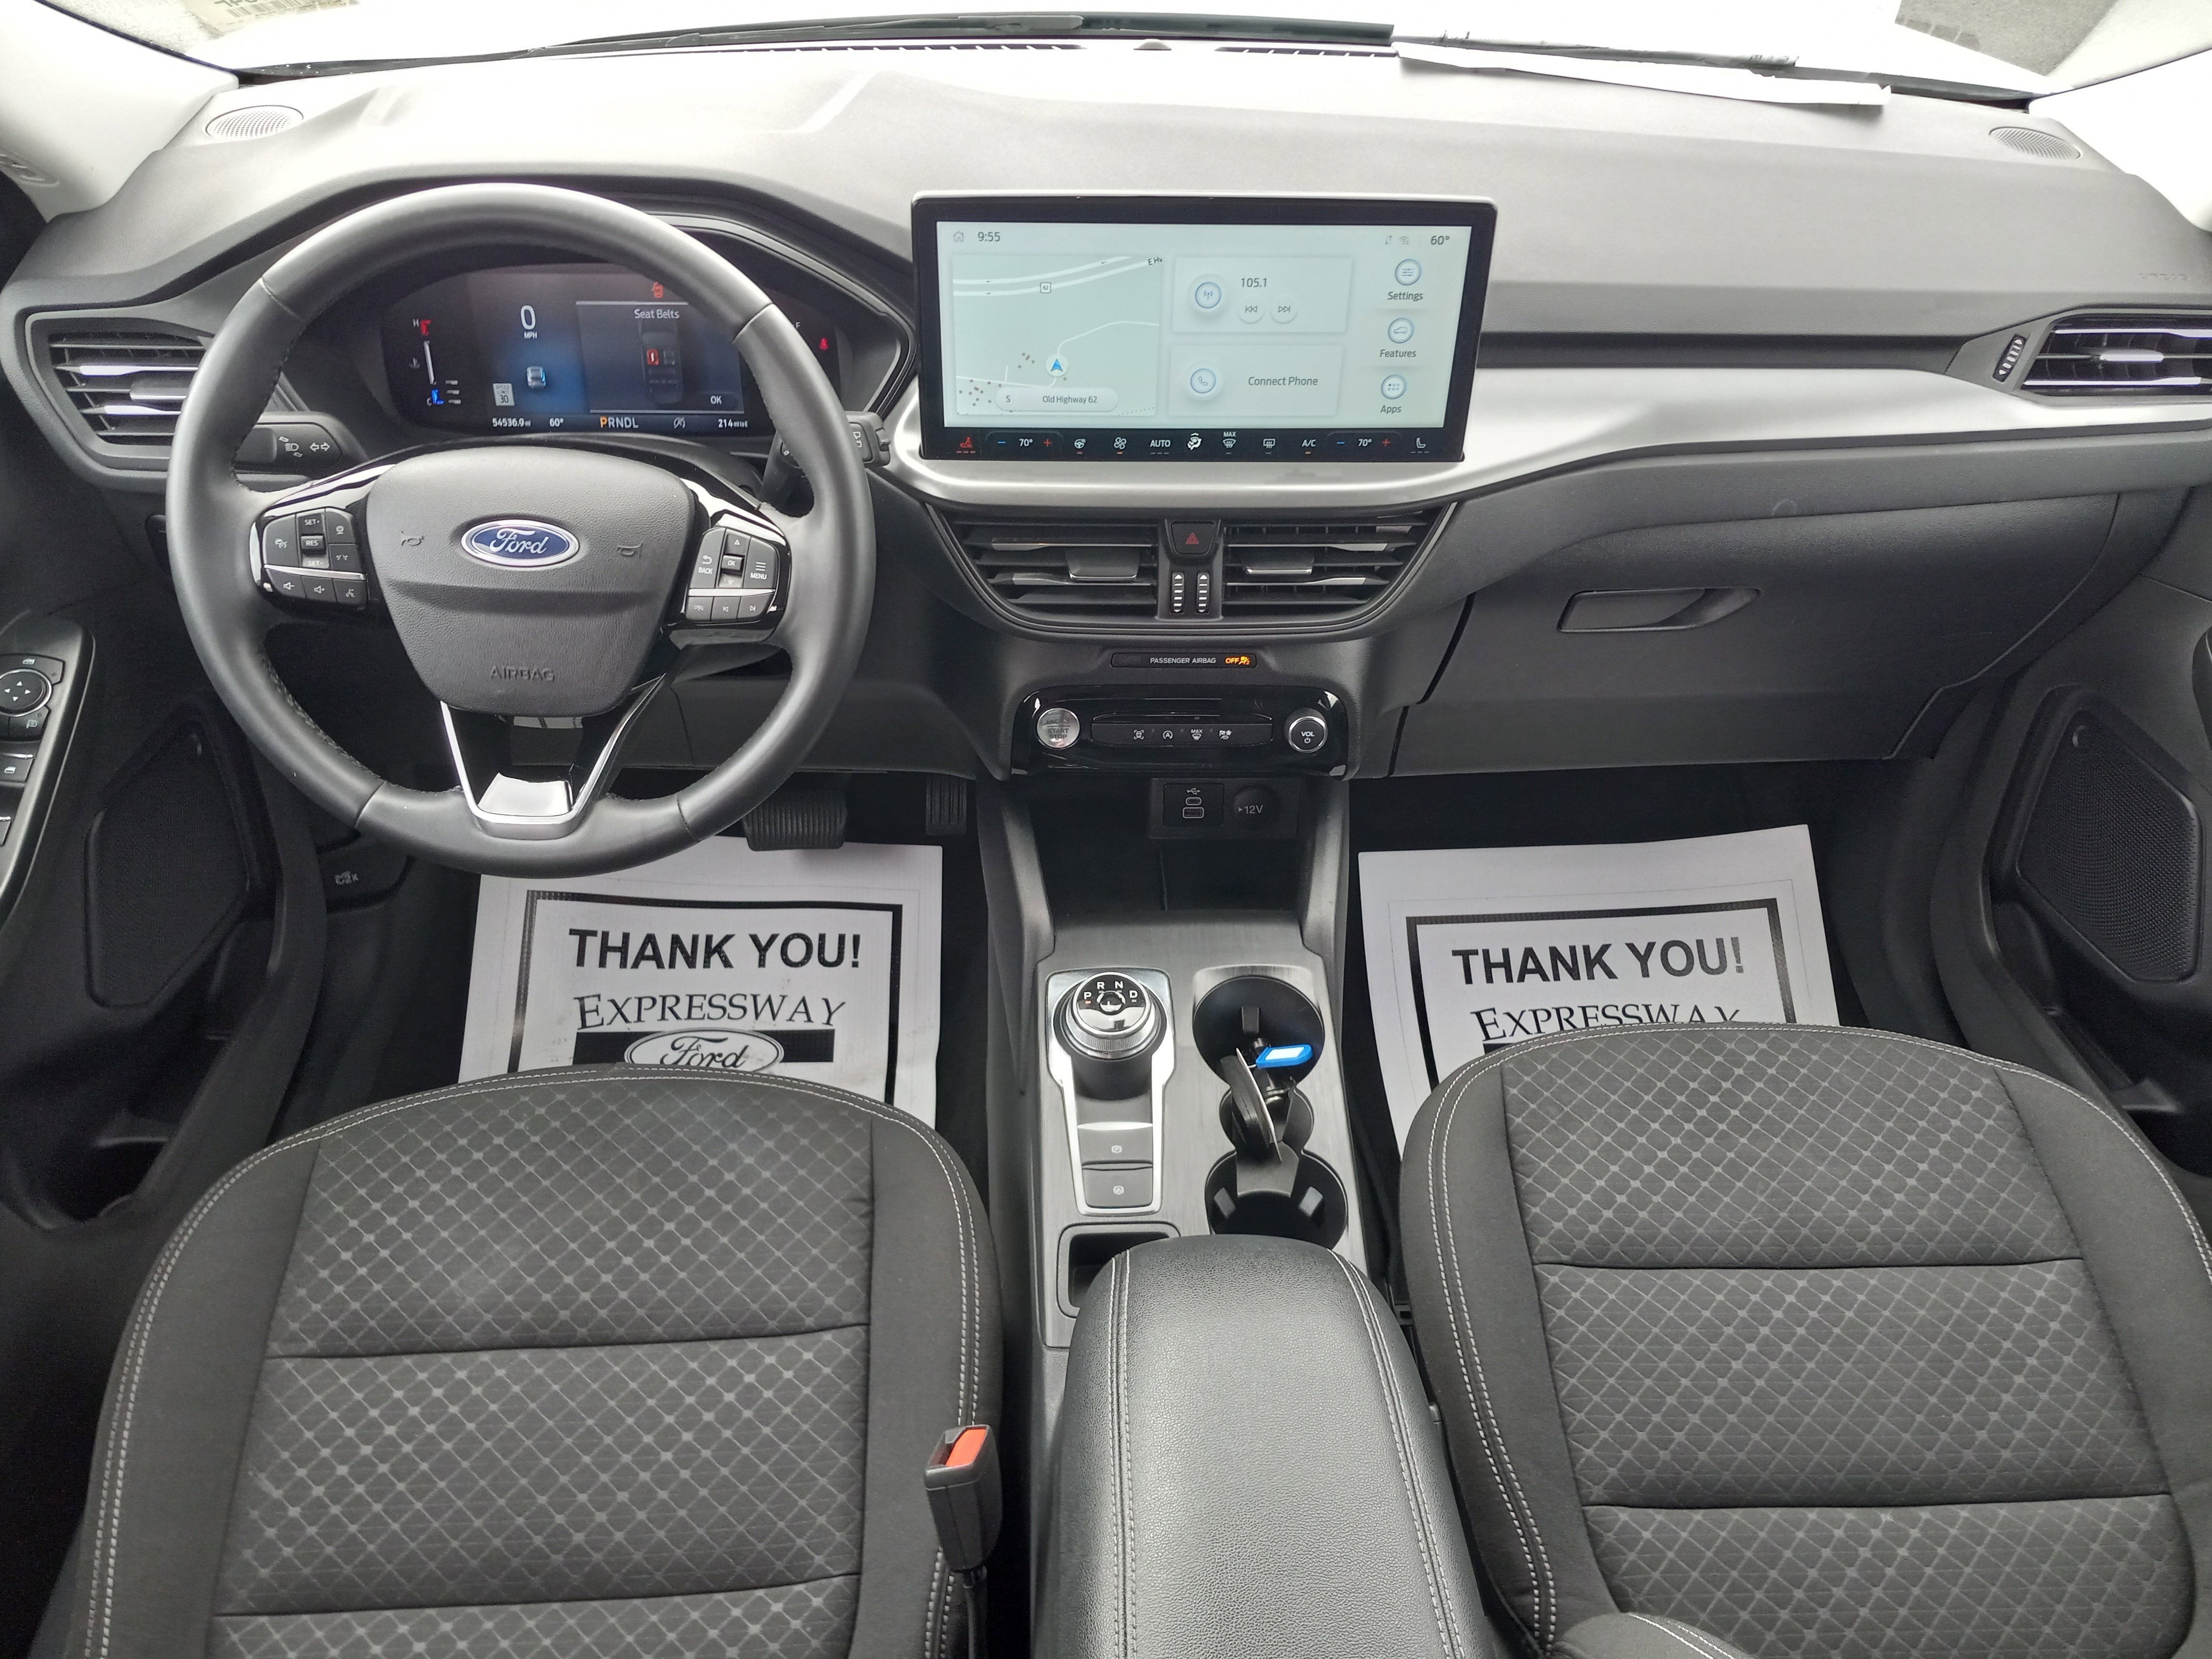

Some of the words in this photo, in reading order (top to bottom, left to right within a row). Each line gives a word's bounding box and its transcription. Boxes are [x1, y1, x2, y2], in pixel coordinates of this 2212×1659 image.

[977, 231, 1000, 241] 9:55
[1431, 236, 1450, 245] 60°
[1240, 277, 1267, 288] 105.1
[1387, 291, 1423, 301] Settings
[520, 305, 536, 330] 0
[634, 309, 655, 319] Seat
[656, 309, 680, 319] Belts
[1380, 349, 1417, 358] Features
[1248, 376, 1286, 385] Connect
[1288, 376, 1318, 385] Phone
[500, 395, 509, 403] 30
[710, 396, 722, 404] OK
[1056, 396, 1087, 405] Highway
[1380, 405, 1402, 414] Apps
[718, 419, 733, 428] 214
[1019, 438, 1033, 447] 70°
[1150, 439, 1171, 448] AUTO
[1358, 438, 1372, 447] 70°
[489, 528, 550, 554] Ford
[698, 566, 713, 575] BACK
[490, 665, 555, 682] AIRBAG
[1244, 805, 1263, 814] 12V
[569, 928, 736, 969] THANK
[748, 933, 862, 969] YOU!
[1451, 943, 1618, 985] THANK
[1624, 936, 1744, 978] YOU!
[1084, 991, 1092, 999] P
[1115, 981, 1123, 989] N
[1129, 990, 1138, 998] D
[659, 1035, 749, 1069] Ford
